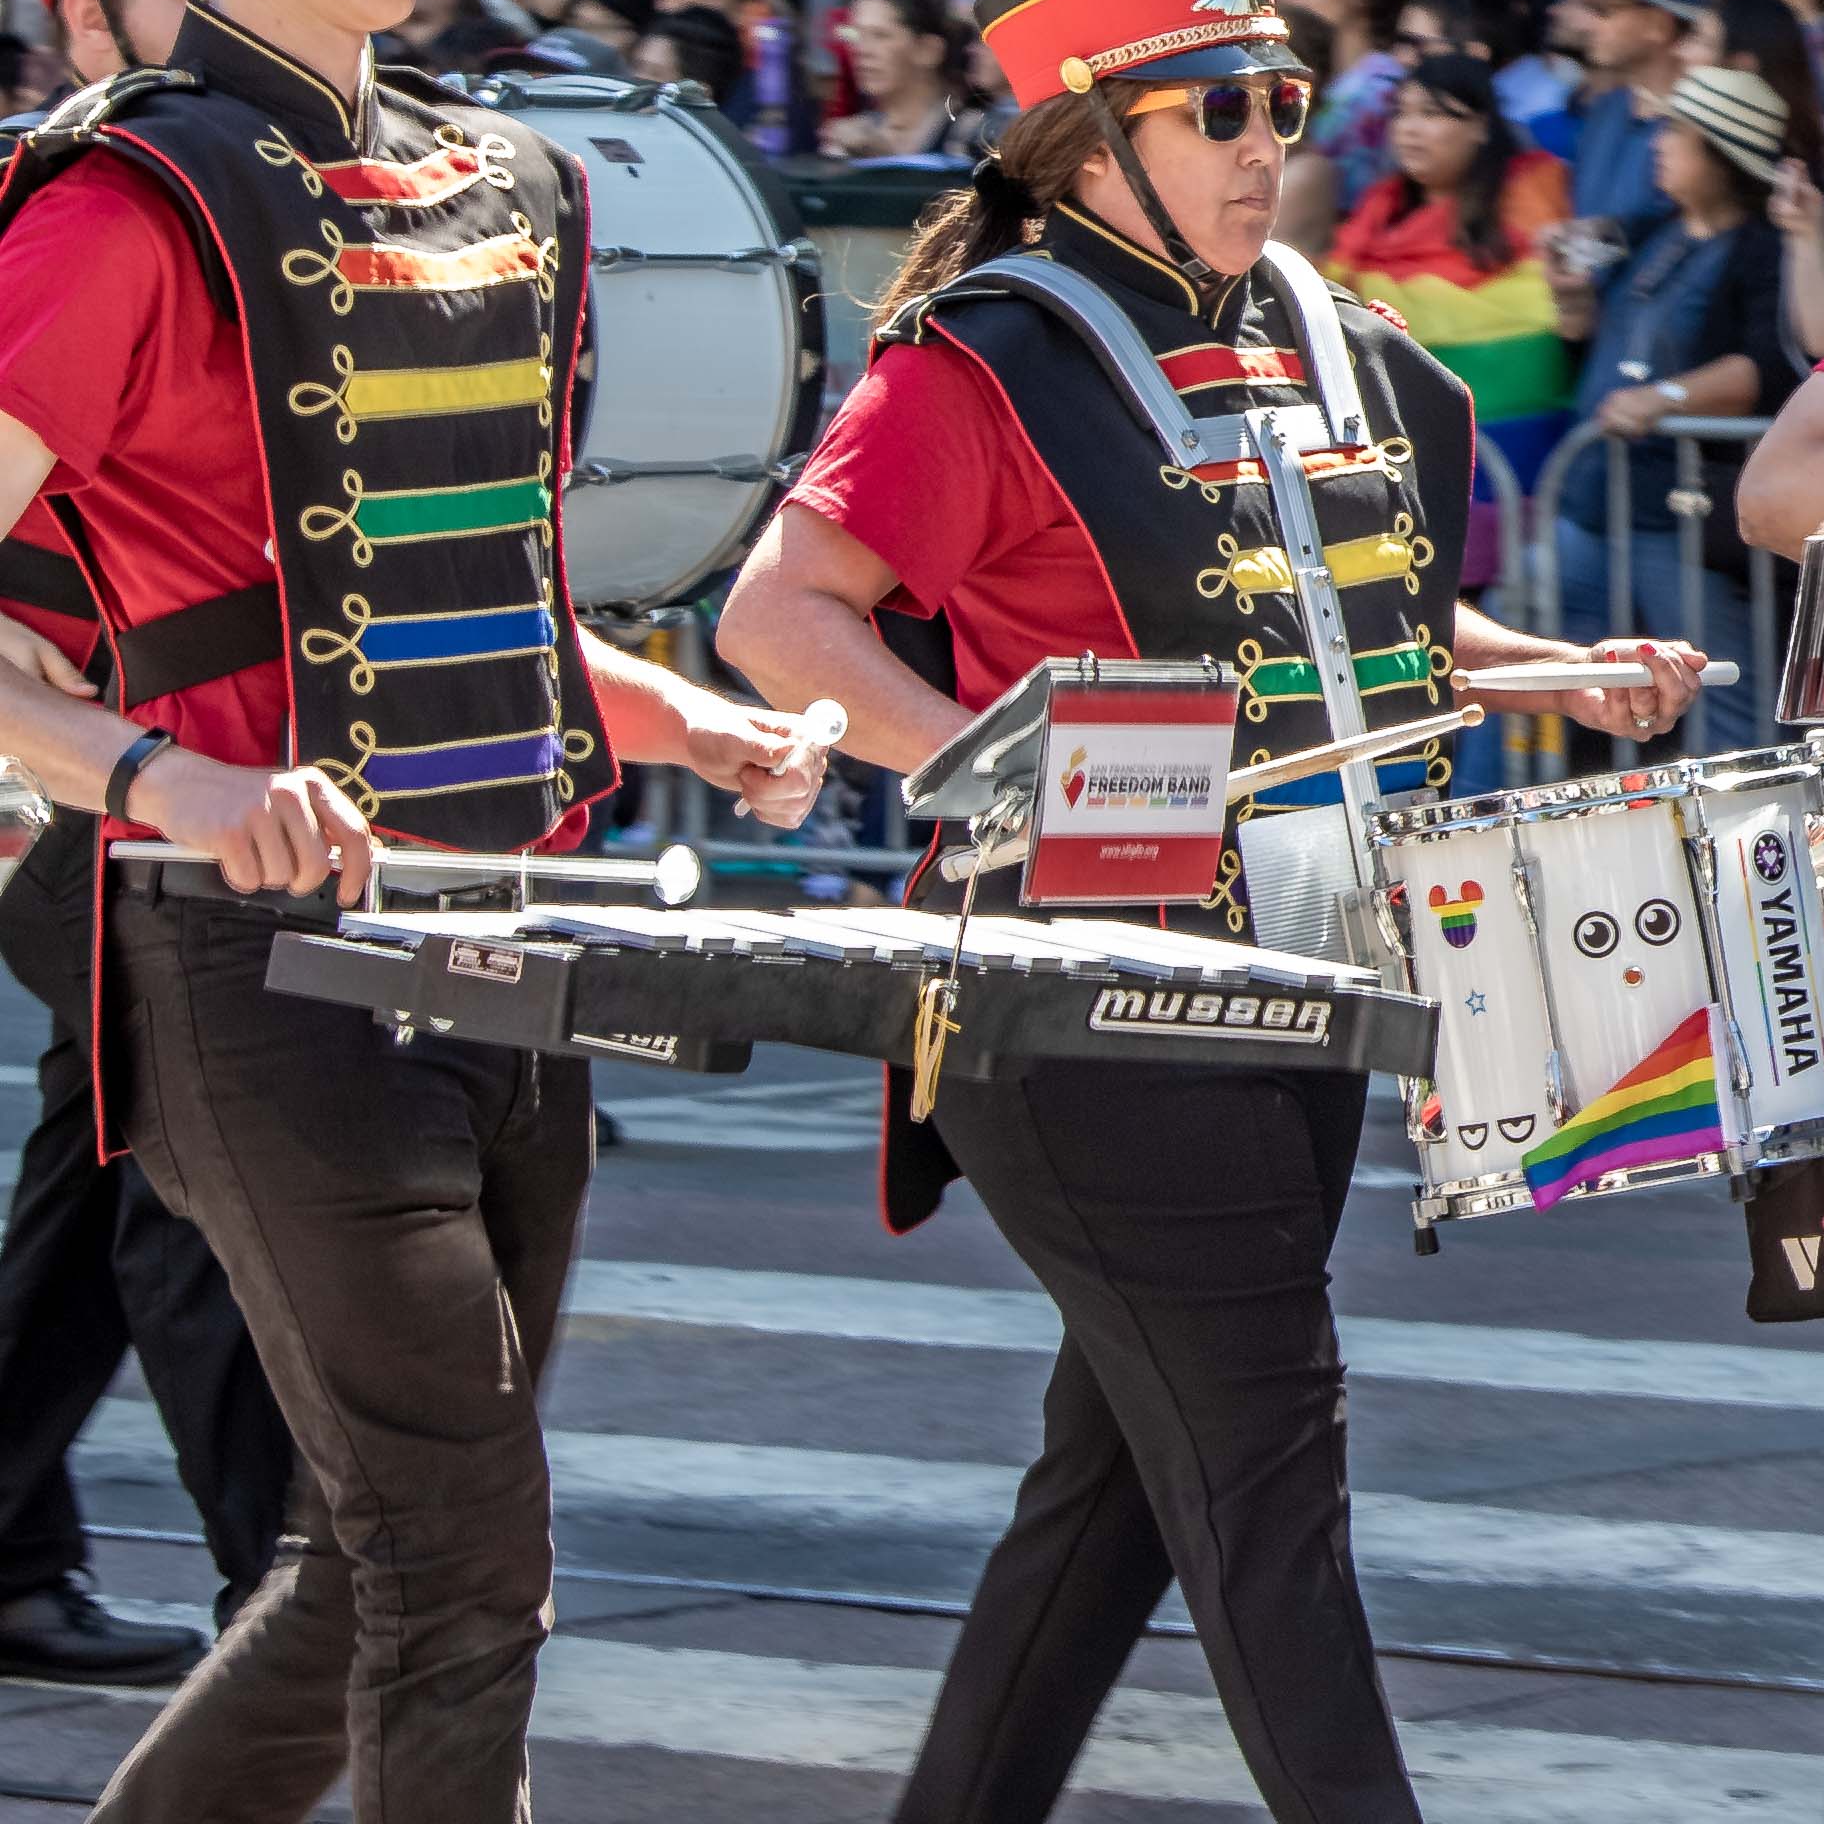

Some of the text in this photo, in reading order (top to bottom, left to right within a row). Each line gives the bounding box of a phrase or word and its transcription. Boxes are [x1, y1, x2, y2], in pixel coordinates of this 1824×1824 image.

[1088, 776, 1211, 794] FREEDOM BAND
[1761, 887, 1819, 1076] YAMAHA
